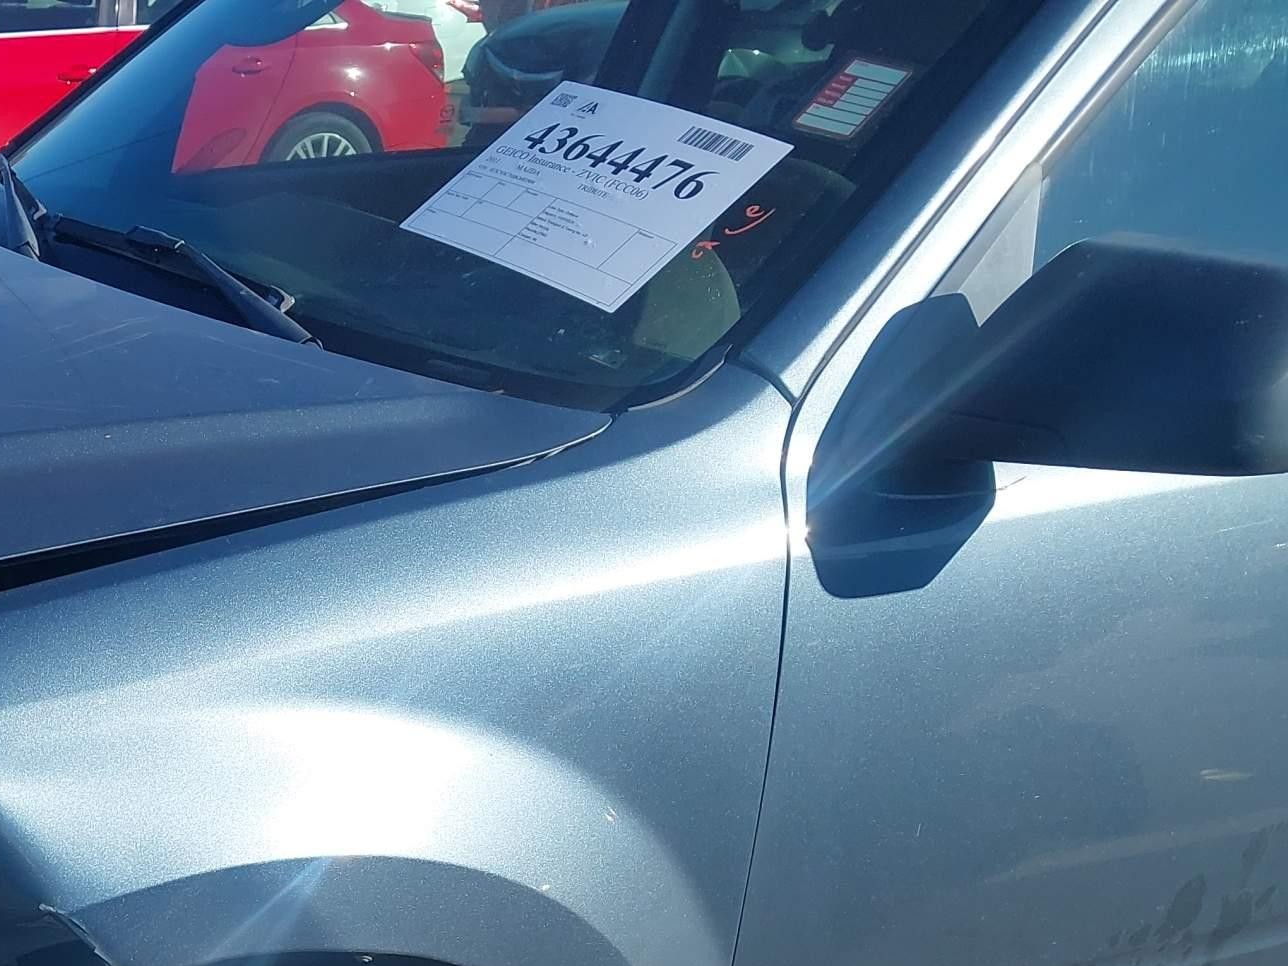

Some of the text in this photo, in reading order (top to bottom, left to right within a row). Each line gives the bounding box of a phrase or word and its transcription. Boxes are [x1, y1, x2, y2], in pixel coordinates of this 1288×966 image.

[496, 145, 530, 160] GEICO
[528, 154, 571, 174] Insurance
[576, 168, 607, 185] ZVIC
[603, 177, 649, 200] (FCC06)
[517, 164, 541, 177] MAZDA
[576, 183, 609, 199] TRIBUTE
[524, 123, 720, 199] 43644476
